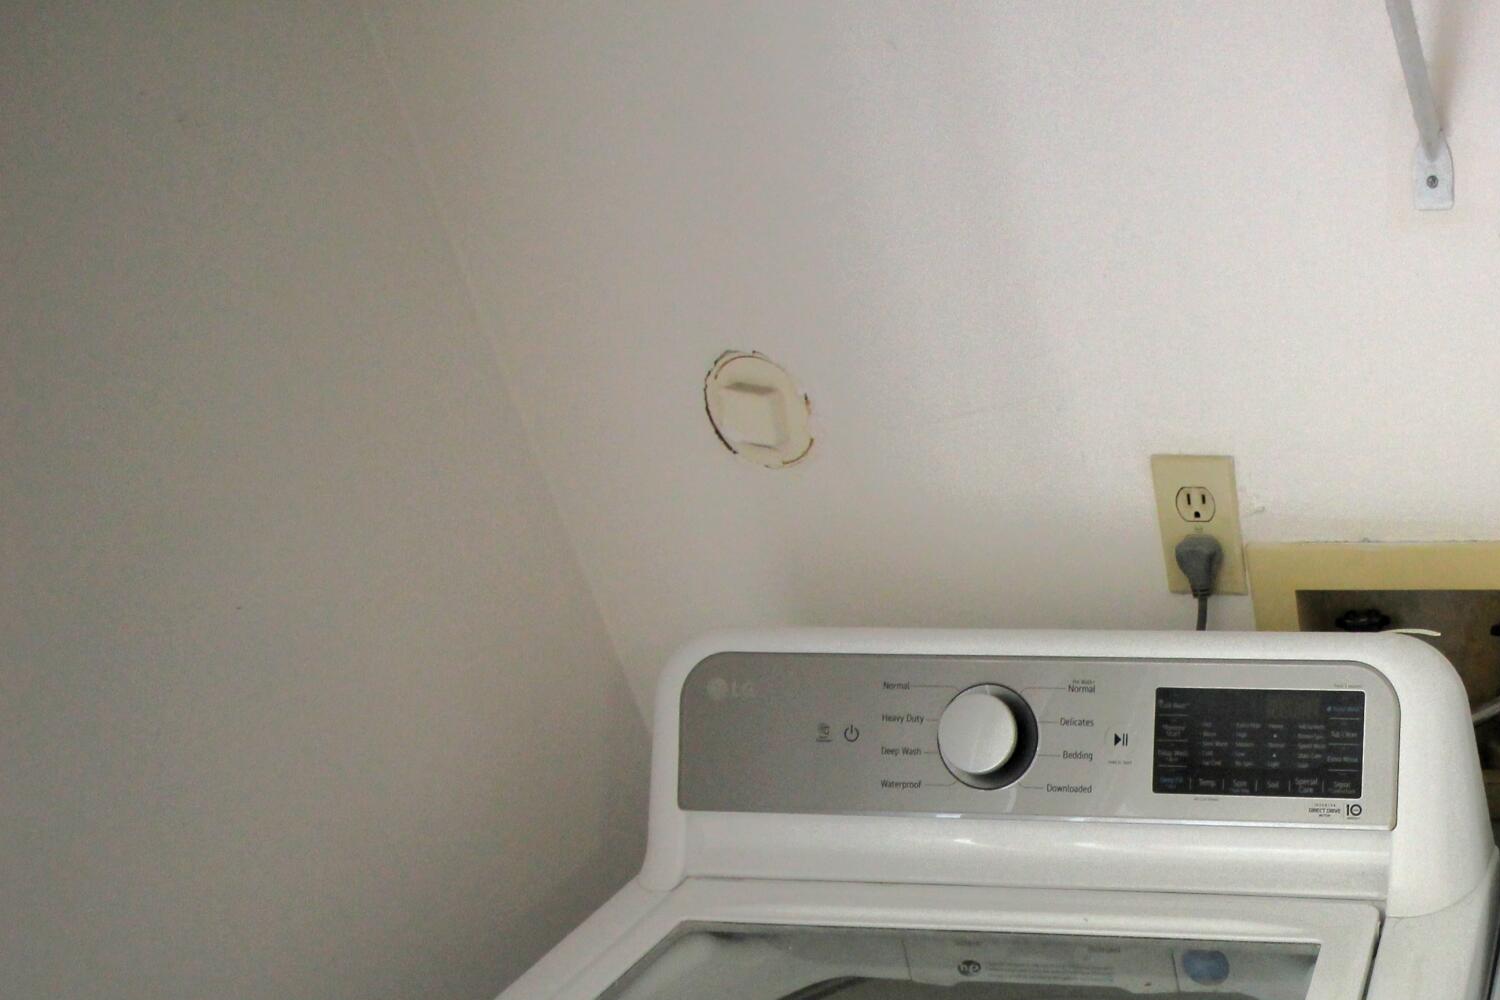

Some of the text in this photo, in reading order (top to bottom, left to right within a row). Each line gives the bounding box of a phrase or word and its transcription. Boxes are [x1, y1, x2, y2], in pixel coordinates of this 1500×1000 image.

[882, 681, 910, 690] Normal
[1067, 684, 1096, 694] Normal
[881, 714, 925, 723] Heavy Duty
[1060, 717, 1095, 727] Delicates
[881, 747, 922, 757] Deep Wash
[1063, 750, 1094, 762] Bedding
[880, 779, 922, 790] Waterproof
[1046, 783, 1093, 793] Downloaded
[1346, 804, 1362, 816] 10
